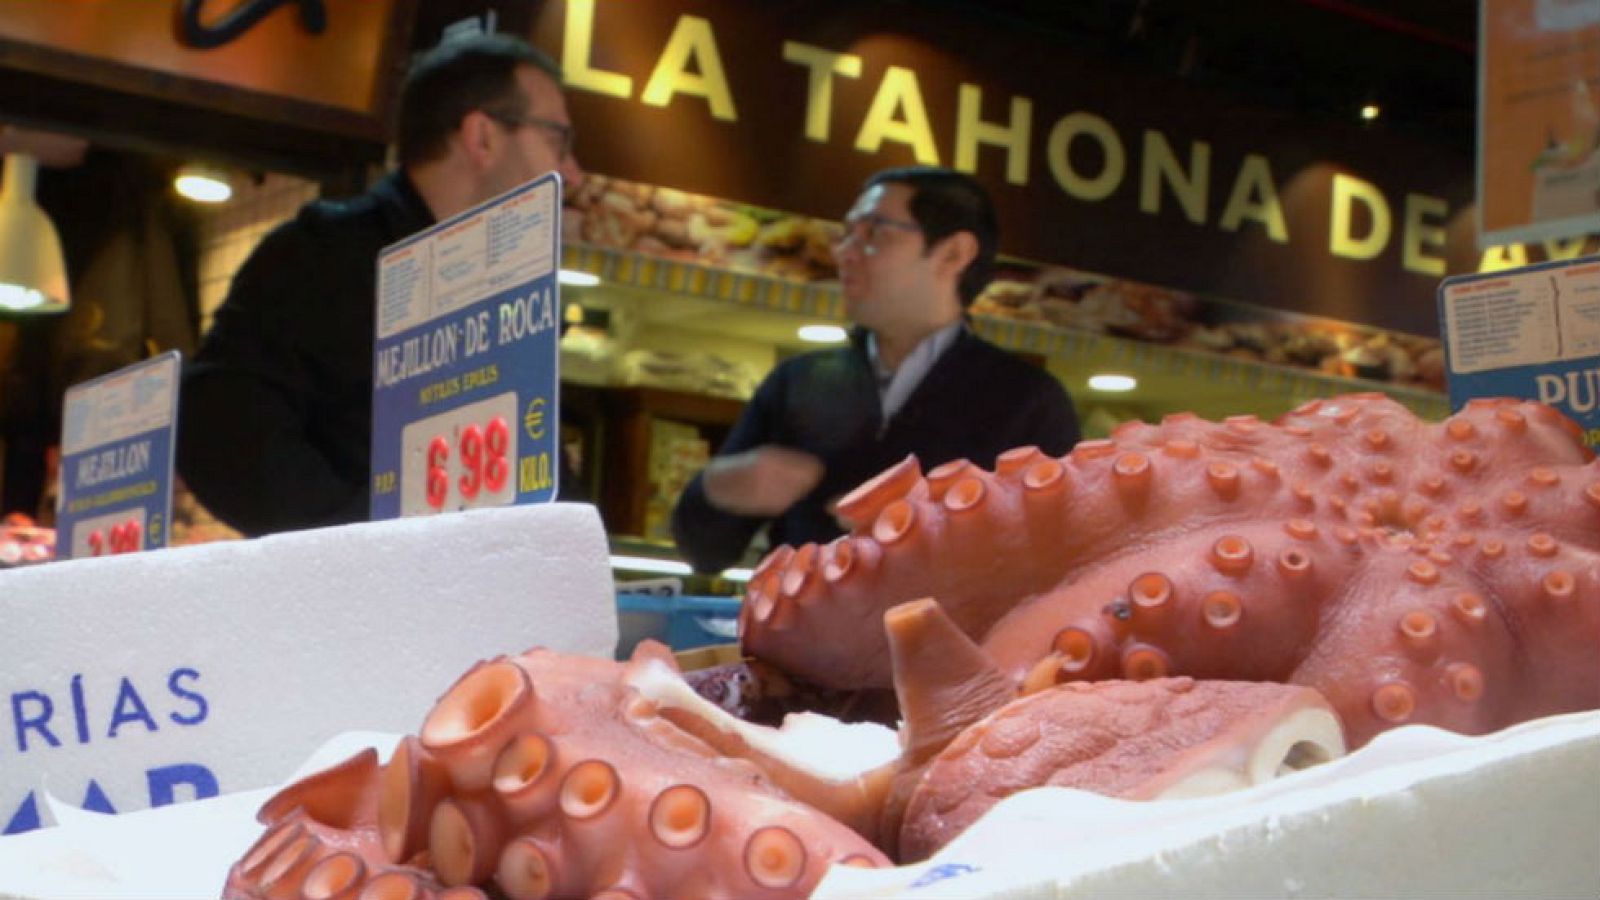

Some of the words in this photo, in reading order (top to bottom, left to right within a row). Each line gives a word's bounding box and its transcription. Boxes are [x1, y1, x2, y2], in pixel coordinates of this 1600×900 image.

[562, 0, 737, 122] LA
[783, 40, 1288, 243] TAHONA
[1330, 173, 1448, 276] DE
[465, 311, 490, 358] DE
[499, 286, 554, 345] ROCA
[524, 397, 546, 440] €
[1535, 370, 1600, 412] PU
